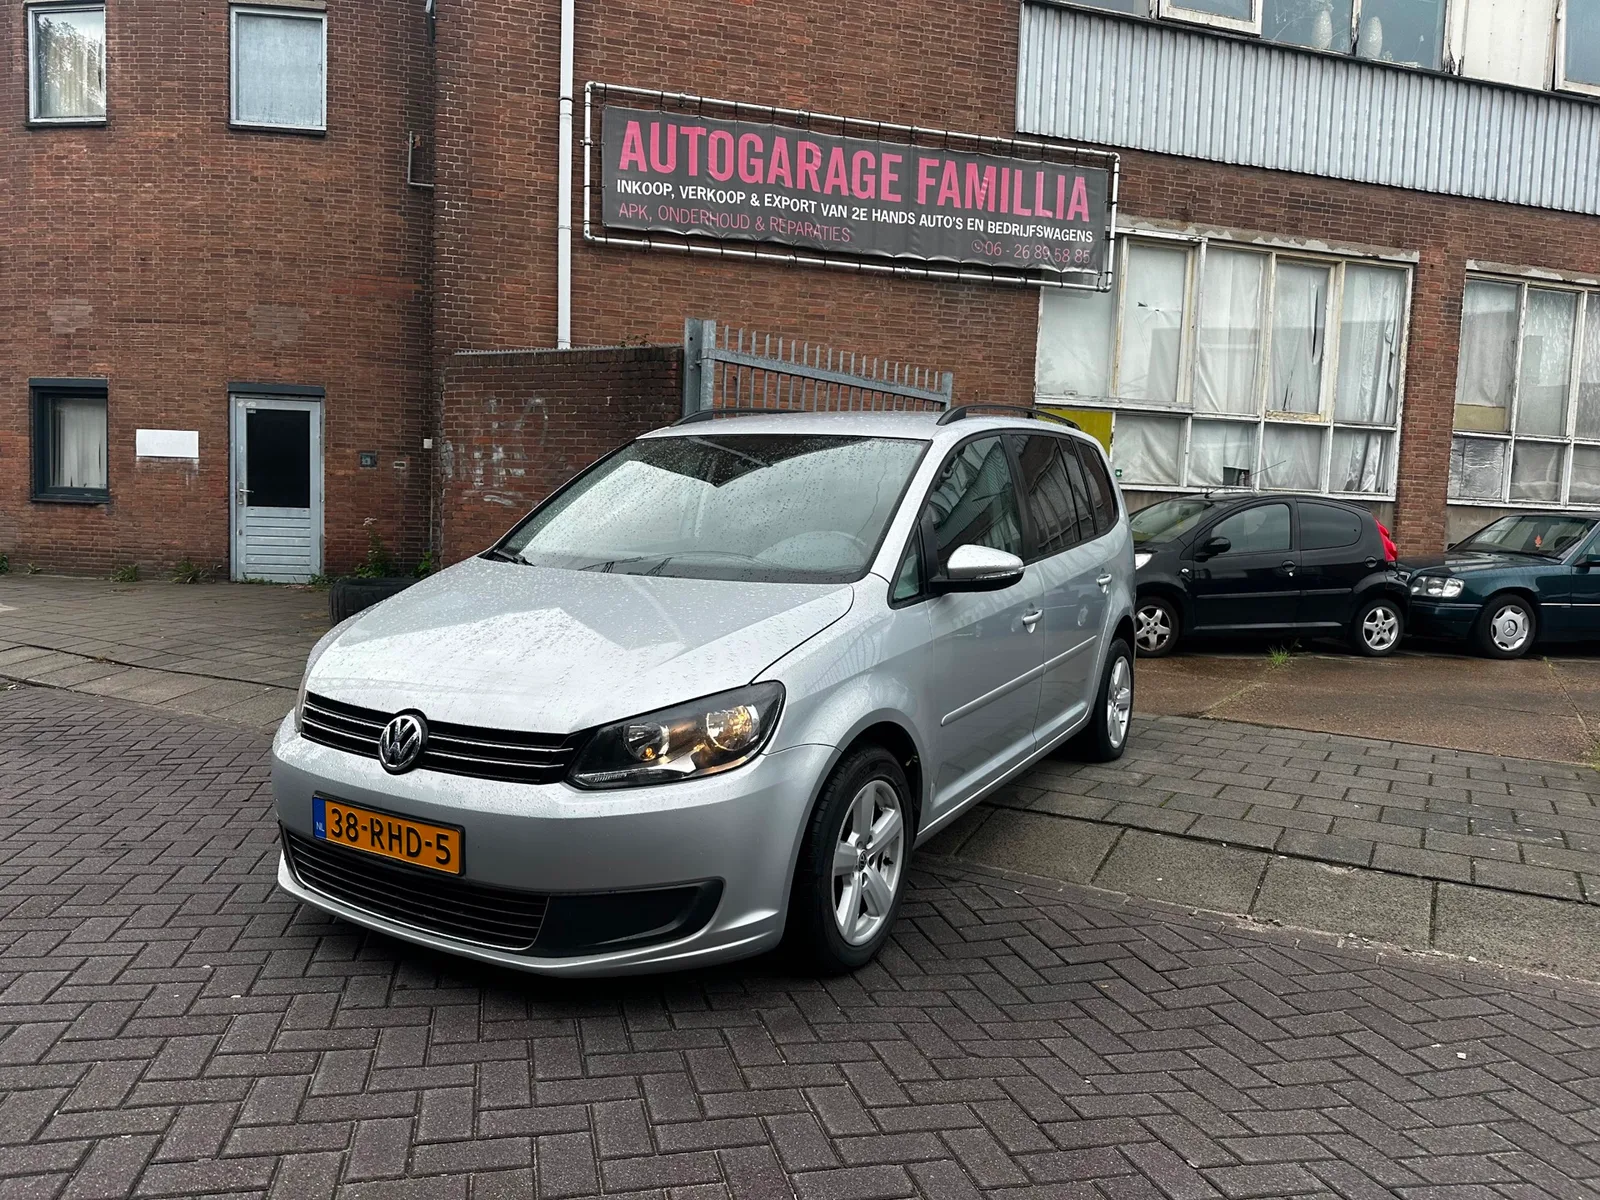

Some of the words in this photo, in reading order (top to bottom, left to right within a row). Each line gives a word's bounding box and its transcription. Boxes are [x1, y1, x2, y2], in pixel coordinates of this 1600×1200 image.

[619, 120, 903, 203] AUTOGARAGE
[917, 157, 1090, 222] FAMILLIA
[617, 179, 675, 199] INKOOP,
[679, 185, 746, 204] VERKOOP
[750, 194, 760, 207] &
[764, 194, 817, 214] EXPORT
[821, 203, 848, 218] VAN
[851, 207, 868, 221] 2E
[872, 209, 916, 225] HANDS
[919, 214, 963, 230] AUTO'S
[967, 218, 984, 232] EN
[987, 221, 1093, 243] BEDRIJFSWAGENS
[618, 203, 652, 223] APK,
[658, 205, 750, 230] ONDERHOUD
[755, 219, 765, 231] &
[769, 217, 851, 243] REPARATIES
[985, 240, 1002, 257] 06
[1014, 243, 1030, 260] 26
[1054, 248, 1070, 263] 58
[1074, 248, 1090, 264] 85
[315, 821, 325, 832] NL
[331, 807, 451, 865] 38-RHD-5
